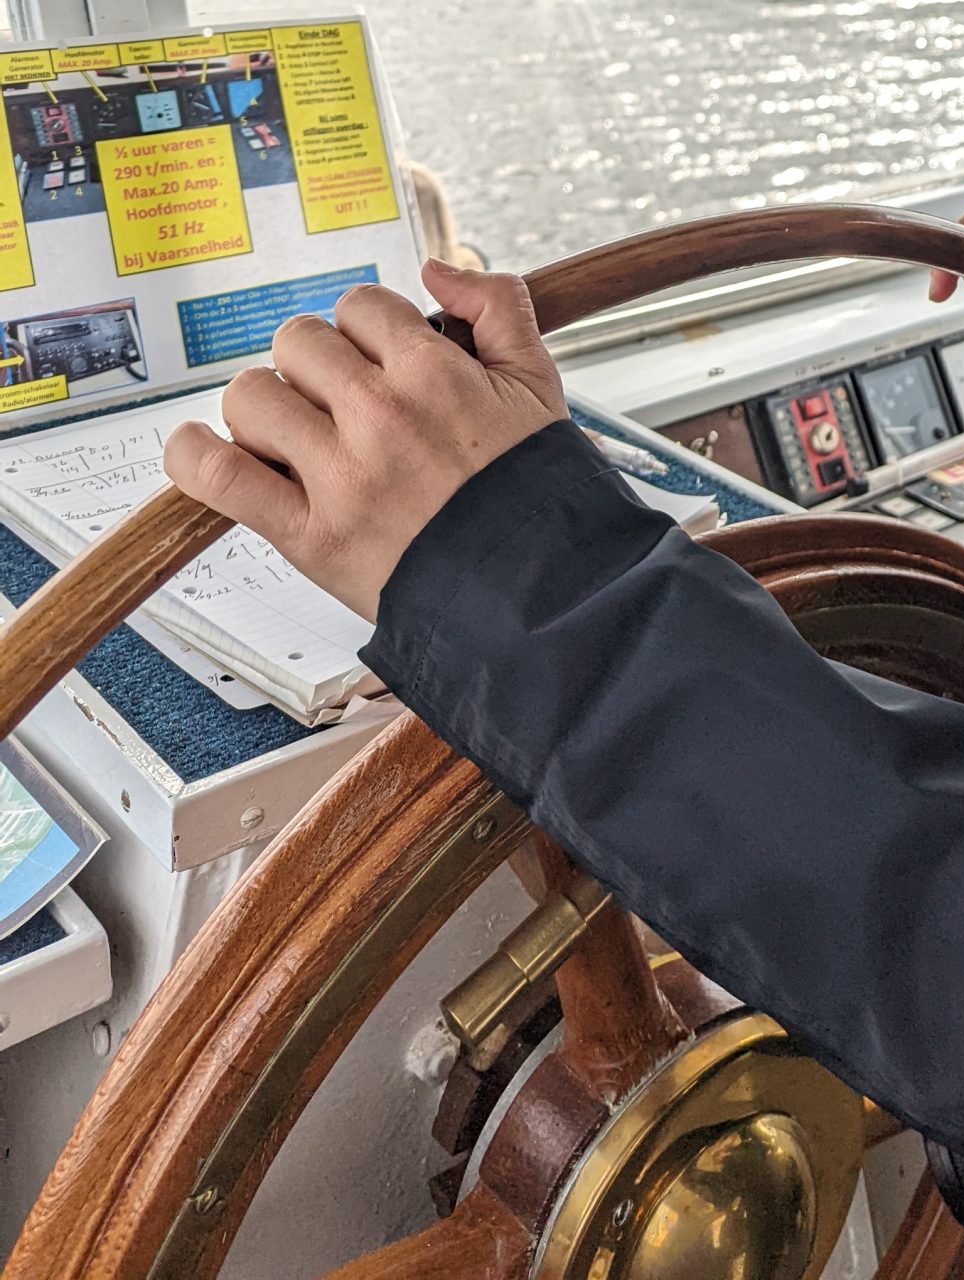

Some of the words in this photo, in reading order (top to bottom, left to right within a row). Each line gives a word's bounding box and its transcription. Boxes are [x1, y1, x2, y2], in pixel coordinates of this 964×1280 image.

[11, 55, 39, 63] Alarmen
[9, 64, 44, 73] Generator
[132, 146, 157, 157] uur
[161, 139, 204, 153] varen
[114, 166, 142, 180] 290
[145, 160, 194, 177] t/min.
[197, 157, 215, 168] en
[184, 178, 223, 192] Amp.
[126, 197, 218, 221] Hoofdmotor
[336, 202, 353, 213] UIT
[158, 224, 178, 240] 51
[184, 222, 205, 236] Hz
[124, 254, 144, 269] bij
[147, 235, 244, 262] Vaarsnelheid
[3, 393, 55, 408] Radio/alarmen
